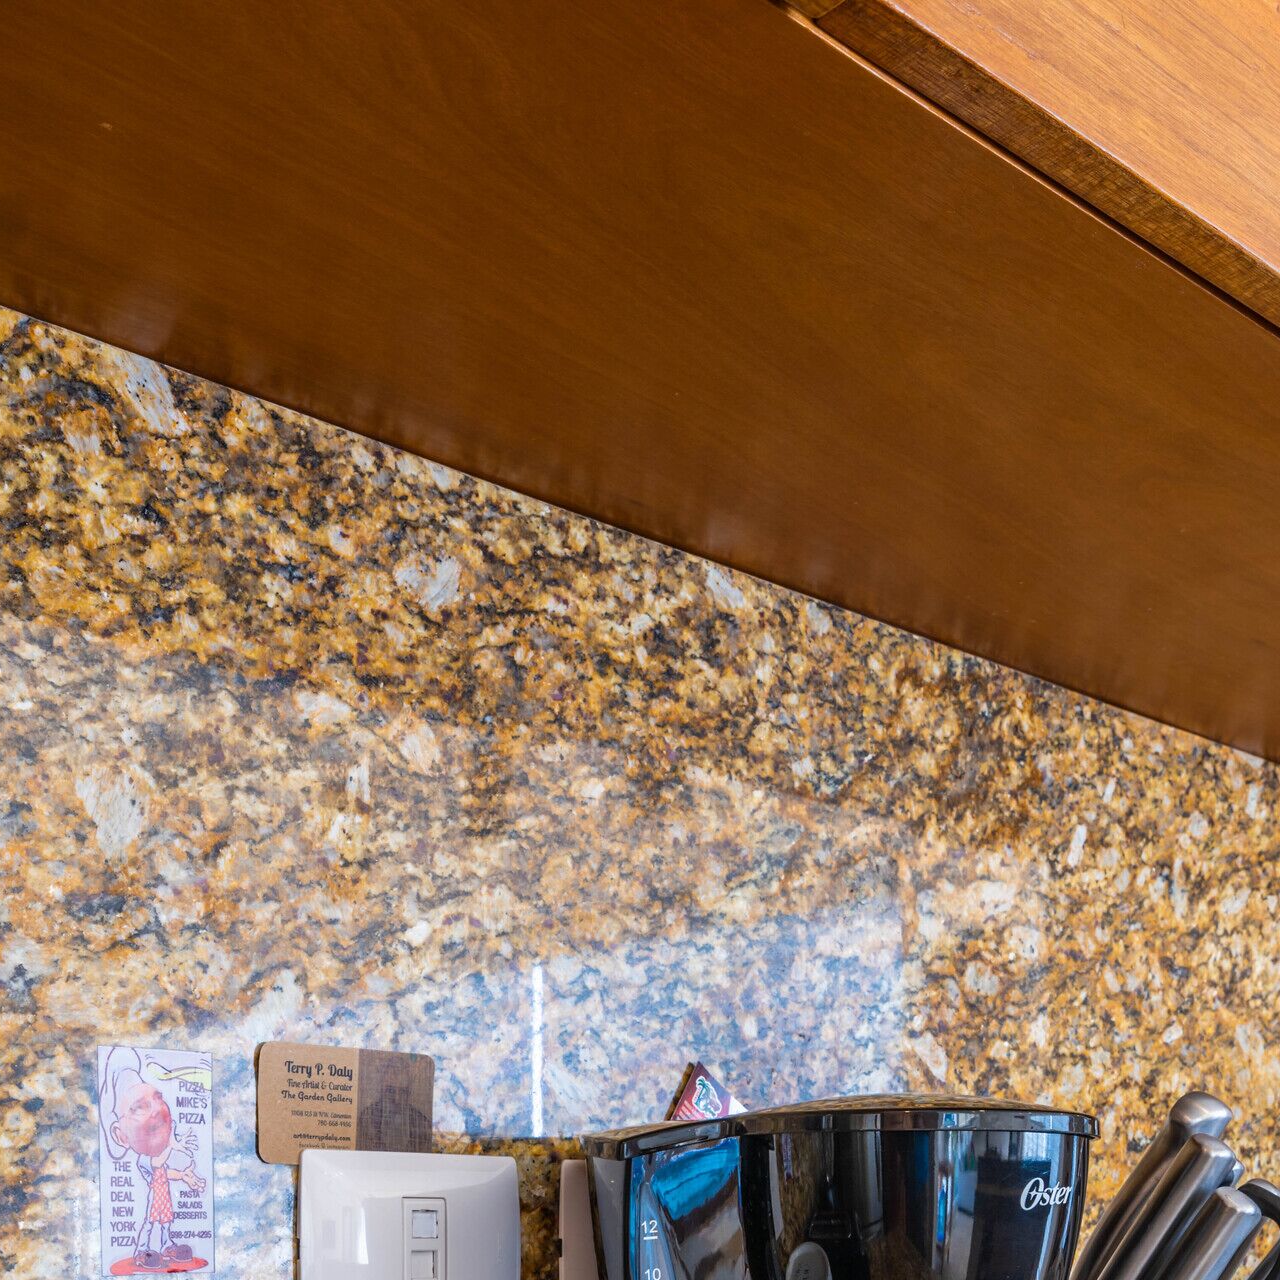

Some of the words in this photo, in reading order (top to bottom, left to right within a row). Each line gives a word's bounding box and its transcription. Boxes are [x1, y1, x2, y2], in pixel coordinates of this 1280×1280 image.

[285, 1060, 312, 1078] Terry
[315, 1063, 325, 1076] P.
[328, 1064, 353, 1081] Daly
[179, 1081, 205, 1092] PIZZA
[287, 1079, 300, 1089] Fine
[328, 1082, 352, 1091] Curator
[281, 1090, 296, 1099] The
[298, 1091, 325, 1101] Garden
[327, 1093, 352, 1104] Gallery
[179, 1113, 206, 1124] PIZZA
[113, 1161, 131, 1172] THE
[111, 1176, 134, 1187] REAL
[111, 1192, 134, 1202] DEAL
[1020, 1177, 1072, 1211] Oster
[177, 1201, 203, 1209] SALADS
[112, 1207, 133, 1217] NEW
[174, 1211, 207, 1219] DESSERTS
[110, 1221, 136, 1231] YORK
[641, 1220, 658, 1234] 12
[111, 1237, 136, 1247] PIZZA
